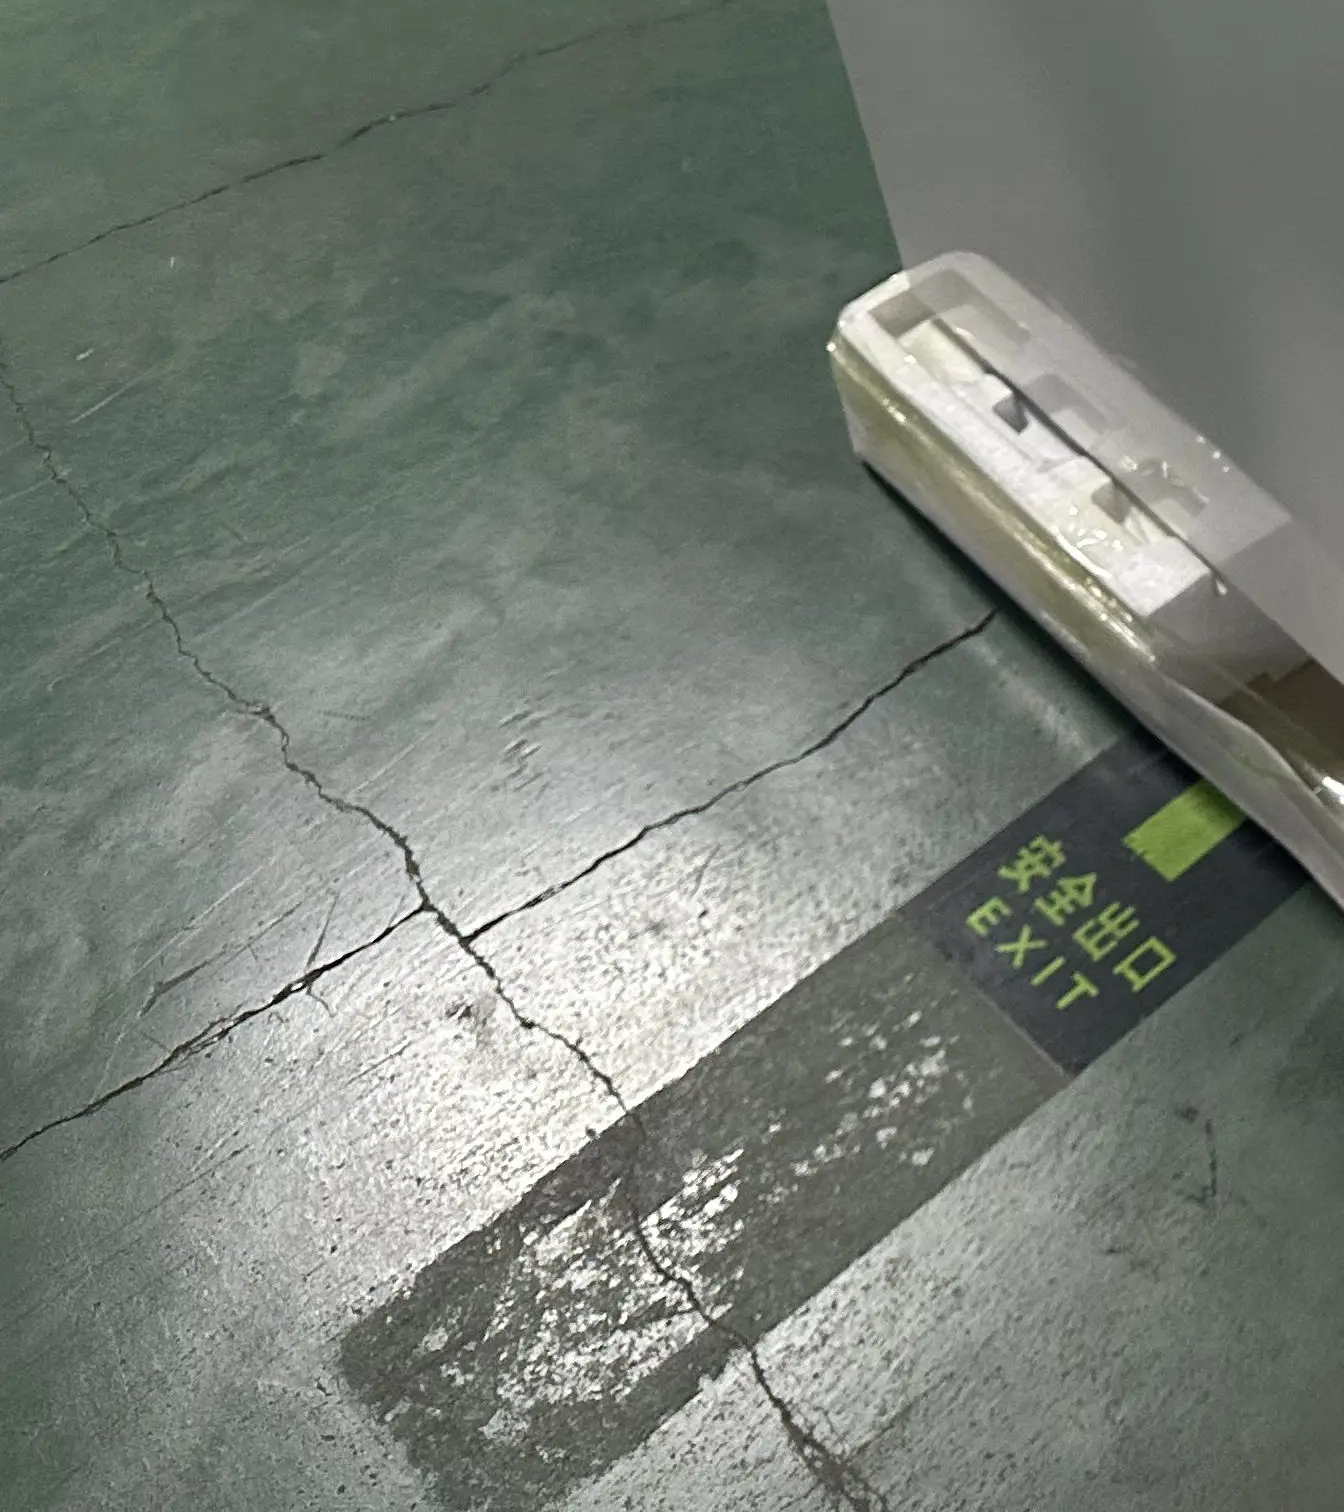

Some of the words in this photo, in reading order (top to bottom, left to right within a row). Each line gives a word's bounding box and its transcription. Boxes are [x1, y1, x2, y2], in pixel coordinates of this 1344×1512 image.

[966, 896, 1100, 1011] EXIT
[997, 834, 1178, 993] 安全出口
